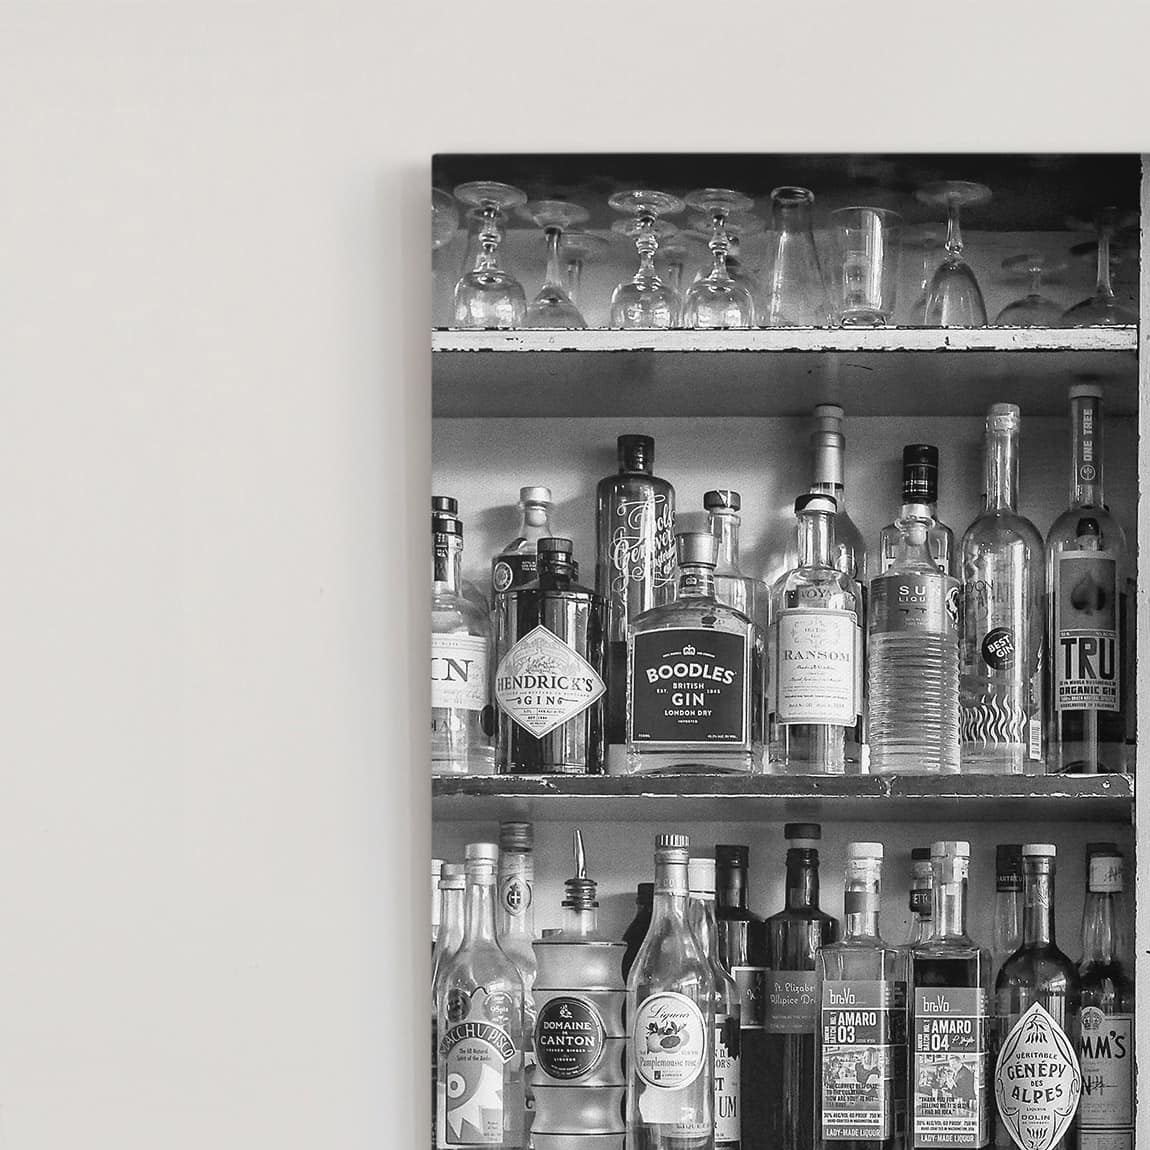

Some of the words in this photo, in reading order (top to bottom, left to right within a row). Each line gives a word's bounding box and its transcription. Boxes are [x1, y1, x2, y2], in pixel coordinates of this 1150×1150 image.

[987, 634, 1011, 654] BEST
[995, 643, 1016, 658] GIN
[783, 649, 850, 663] RANSOM
[1060, 638, 1115, 680] TRU
[646, 662, 735, 685] BOODLES
[497, 674, 594, 693] HENDRICK'S
[672, 682, 705, 690] BRITISH
[1059, 686, 1100, 695] ORGANIC
[1102, 686, 1116, 695] GIN
[523, 695, 556, 705] GIN
[671, 692, 705, 707] GIN
[664, 709, 696, 717] LONDON
[697, 709, 713, 717] DRY
[543, 1021, 593, 1031] DOMAINE
[837, 1011, 877, 1026] AMARO
[931, 1019, 972, 1034] AMARO
[540, 1035, 596, 1047] CANTON
[837, 1025, 855, 1044] 03
[931, 1033, 950, 1051] 04
[487, 1026, 515, 1059] PISCO
[1007, 1060, 1068, 1081] GÉNÉPY
[1030, 1080, 1044, 1088] DES
[1011, 1083, 1063, 1104] ALPES
[1021, 1114, 1051, 1122] DOLIN
